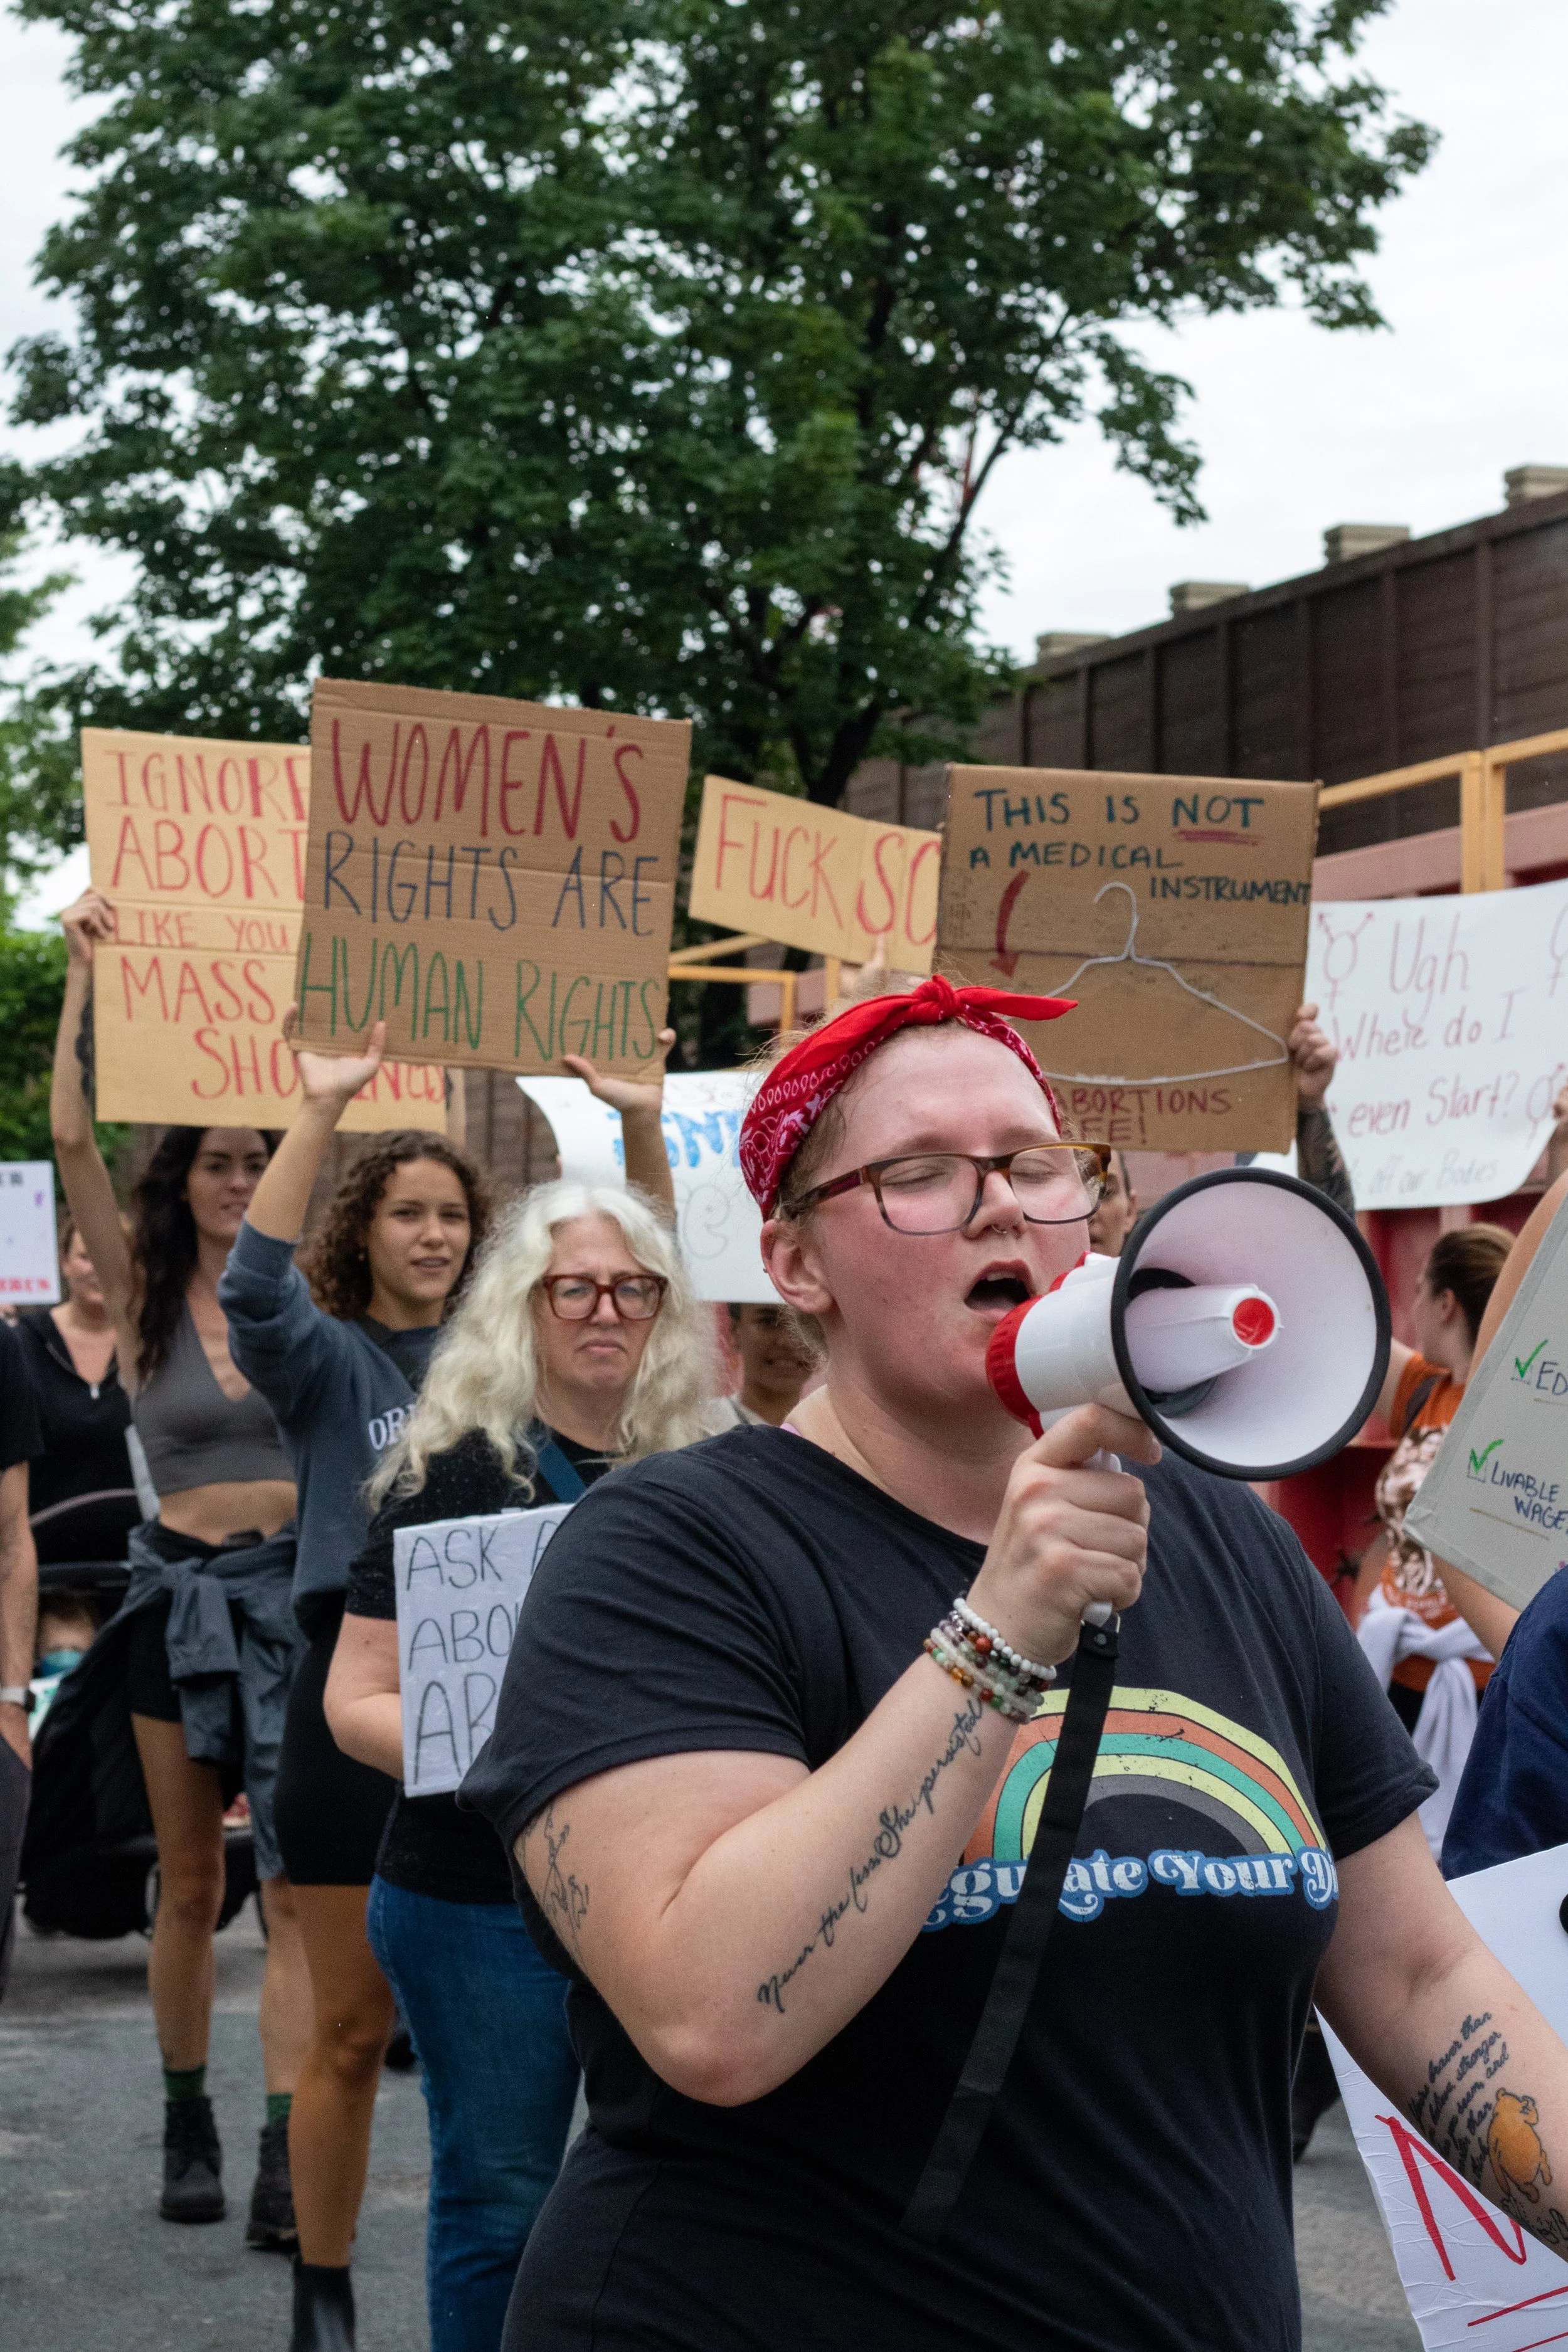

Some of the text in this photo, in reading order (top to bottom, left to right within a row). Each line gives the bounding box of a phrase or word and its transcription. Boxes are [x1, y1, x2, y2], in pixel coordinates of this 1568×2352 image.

[332, 718, 644, 843] WOMEN'S
[973, 788, 1265, 832] THIS IS NOT
[110, 815, 309, 902] ABORT
[715, 793, 845, 930] FUCK
[970, 841, 1185, 871] A MEDICAL
[324, 830, 659, 937] RIGHTS ARE
[1150, 875, 1312, 906] INSTRUMENT
[114, 908, 291, 953] LIKE YOU
[120, 955, 276, 1025] MASS
[1389, 911, 1470, 1025] Ugh
[298, 933, 660, 1061] HUMAN RIGHTS
[1443, 1005, 1483, 1048] do
[1496, 987, 1530, 1041] I
[1346, 1098, 1411, 1139] even
[1535, 1360, 1568, 1396] ED
[368, 1402, 416, 1451] OR
[1490, 1459, 1560, 1503] LIVABLE
[406, 1525, 502, 1592] ASK
[1153, 1854, 1293, 1890] Your
[1300, 1851, 1339, 1903] Di
[1486, 2042, 1510, 2079] and
